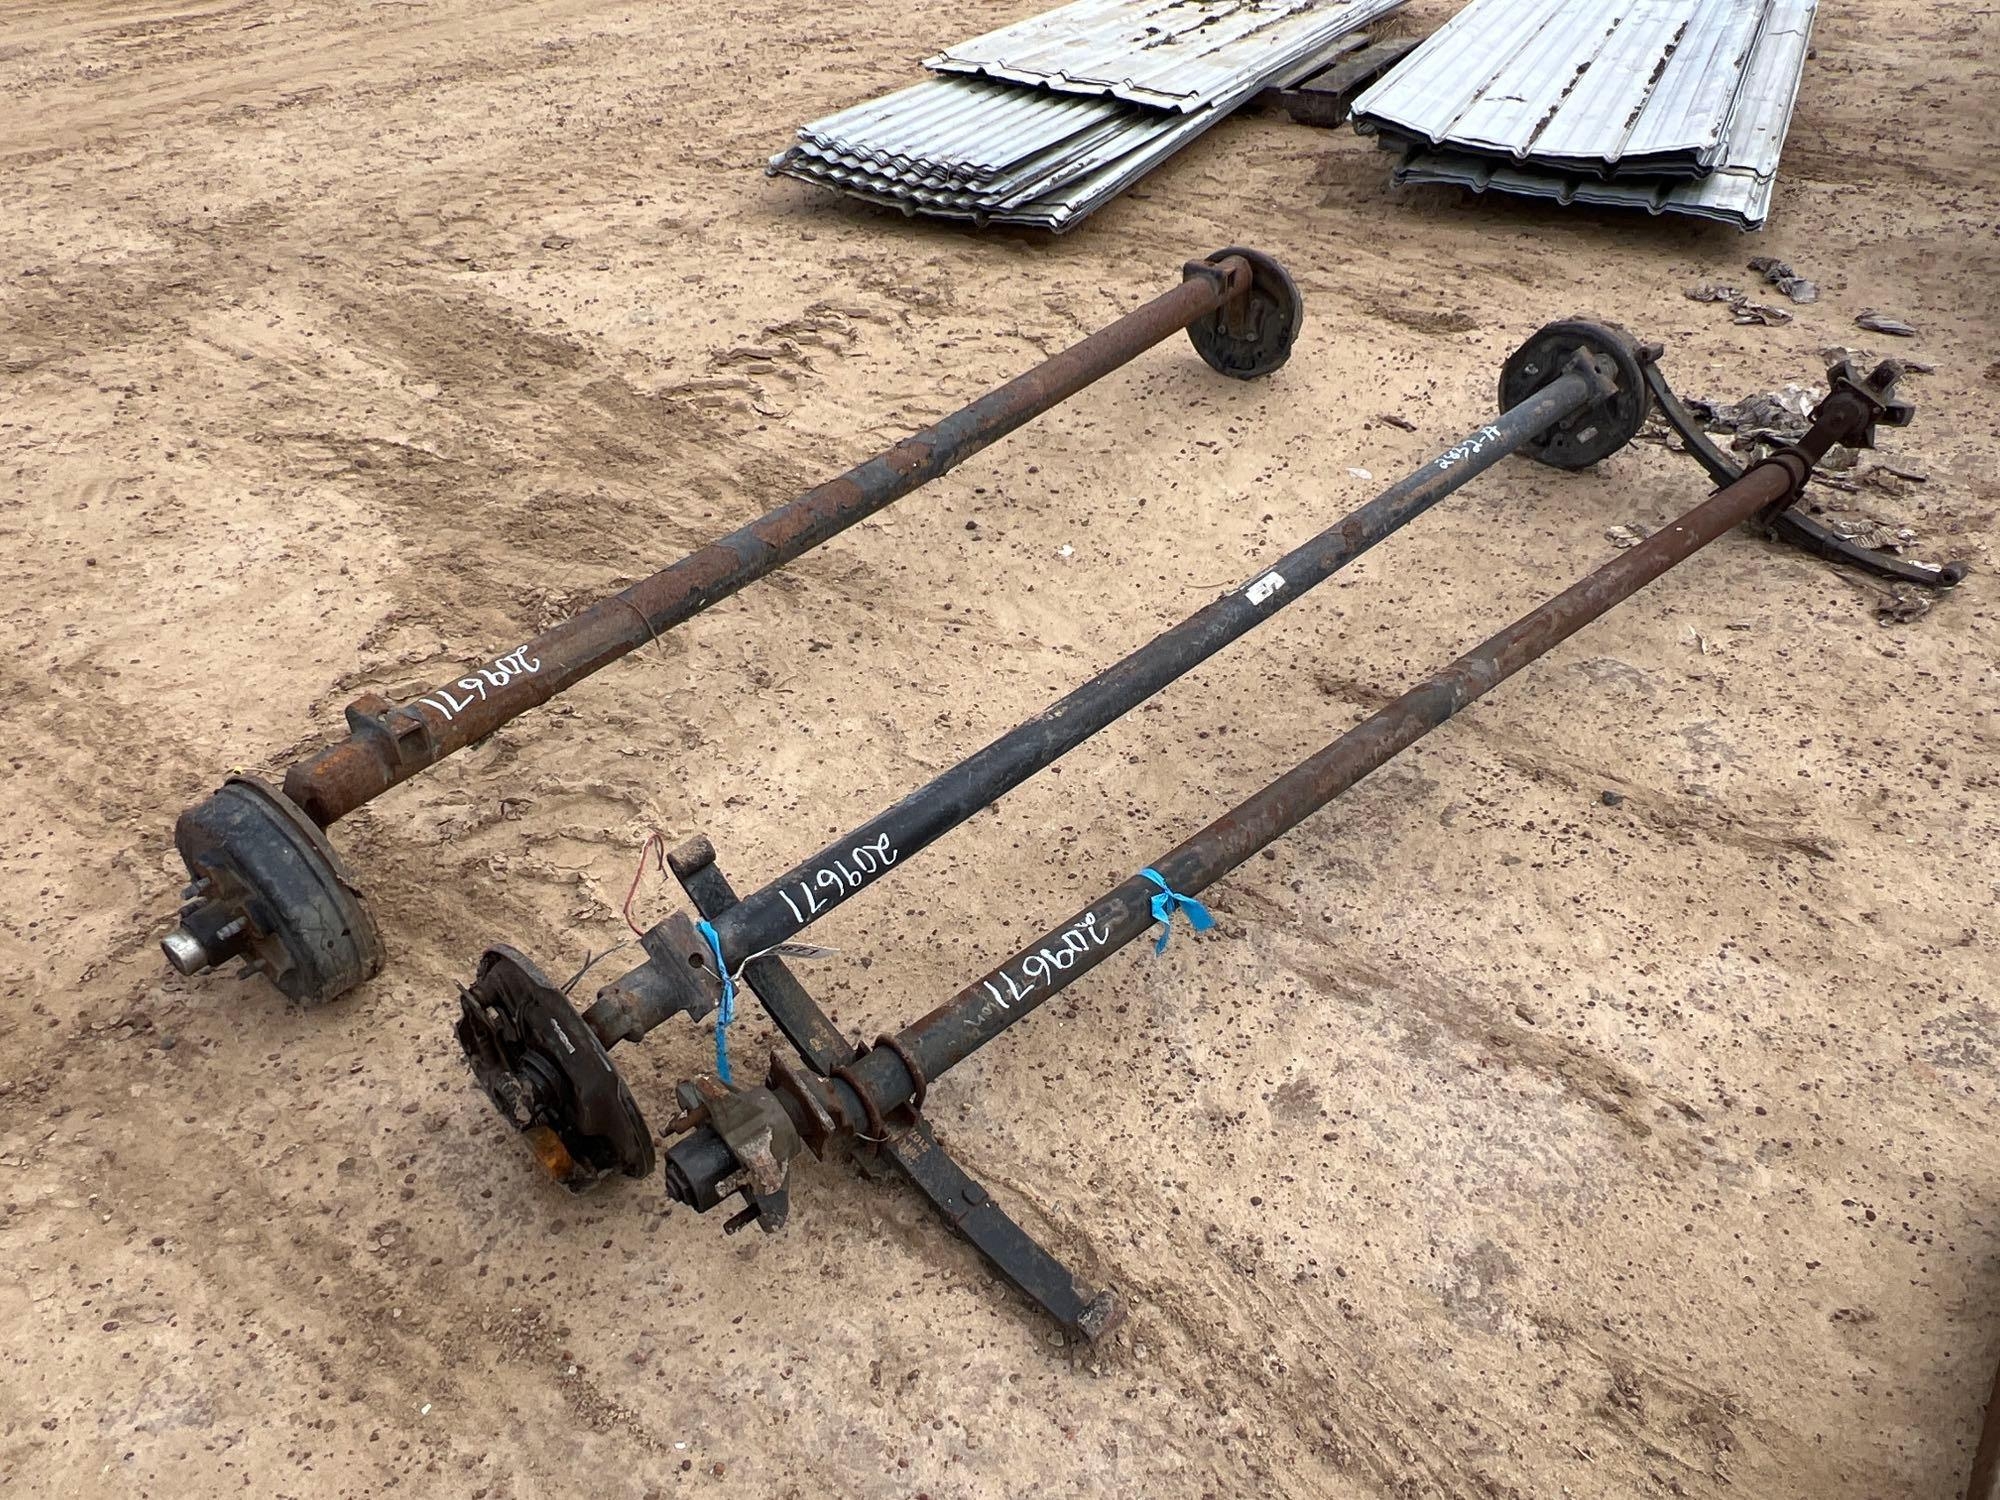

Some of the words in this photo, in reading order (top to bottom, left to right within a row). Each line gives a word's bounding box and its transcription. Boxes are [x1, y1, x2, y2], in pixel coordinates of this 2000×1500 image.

[418, 644, 540, 721] 209671
[778, 832, 898, 923] 209671
[983, 911, 1109, 1009] 209671
